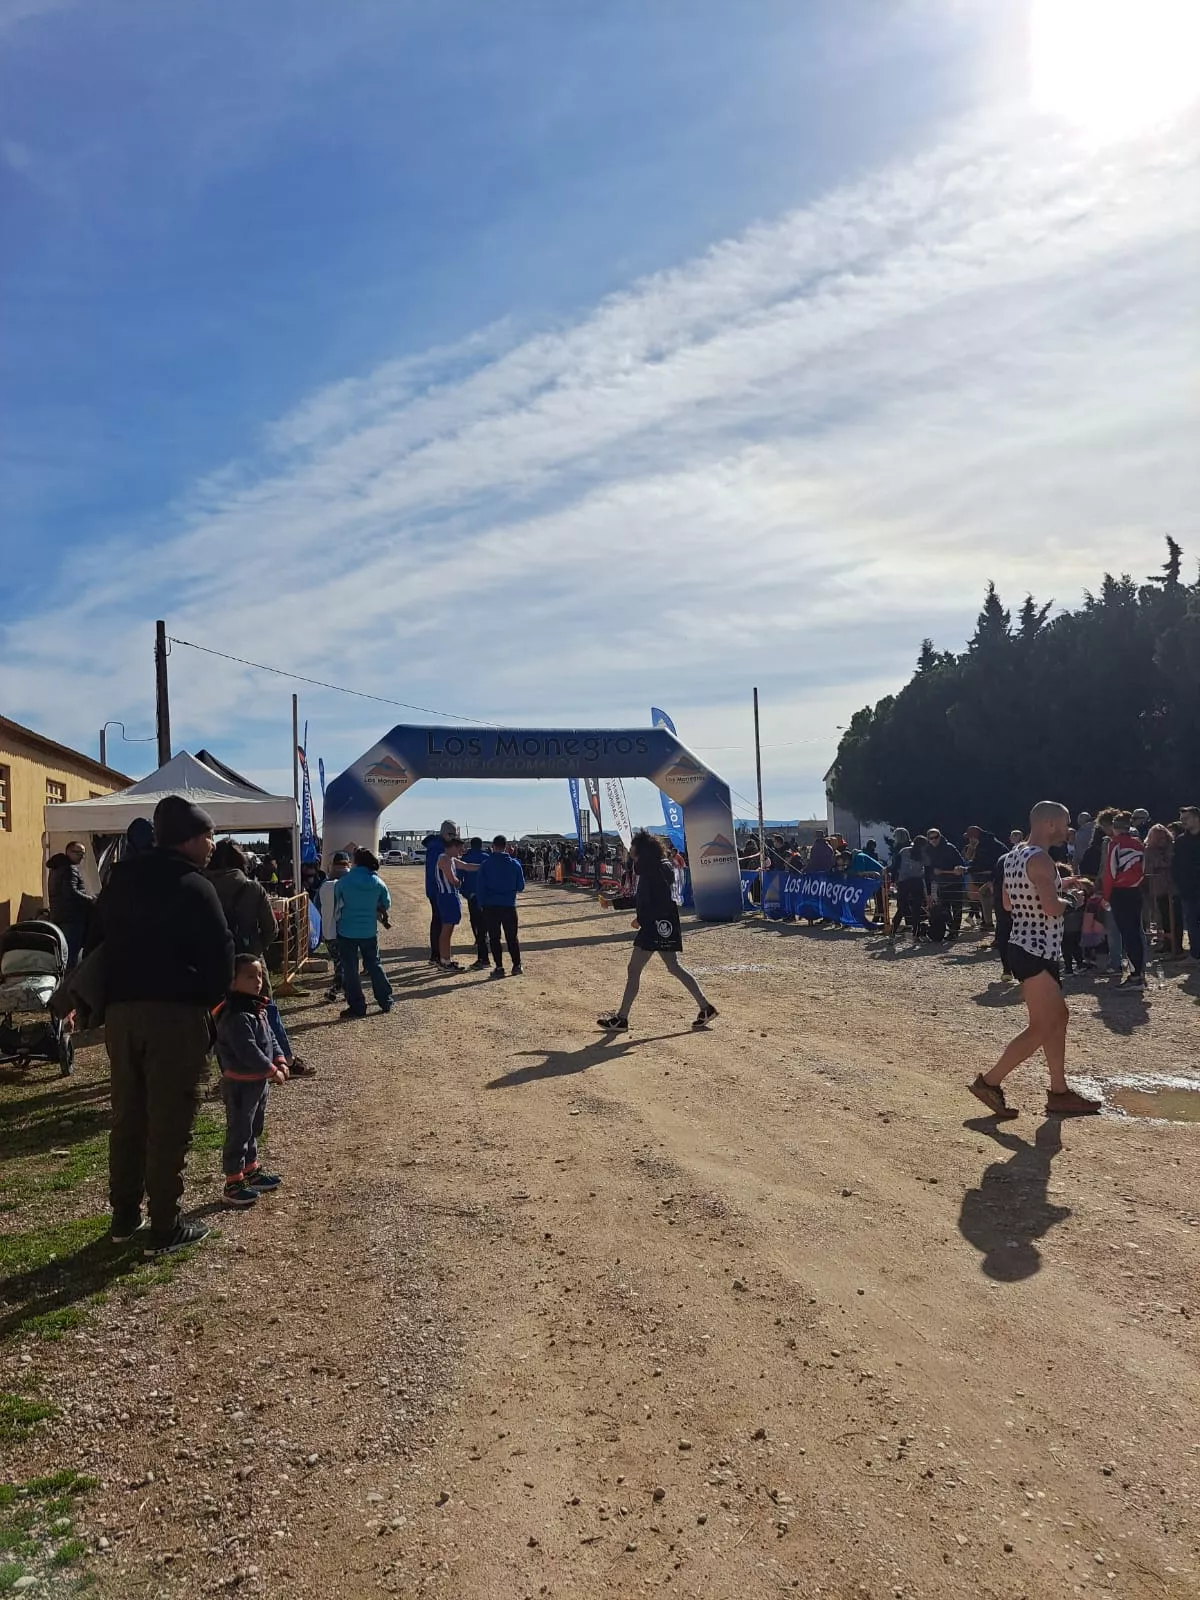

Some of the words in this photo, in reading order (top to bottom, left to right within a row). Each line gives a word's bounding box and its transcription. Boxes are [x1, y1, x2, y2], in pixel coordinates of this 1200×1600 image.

[428, 731, 481, 756] Los
[495, 732, 648, 761] Monegros
[802, 880, 863, 905] Monegros
